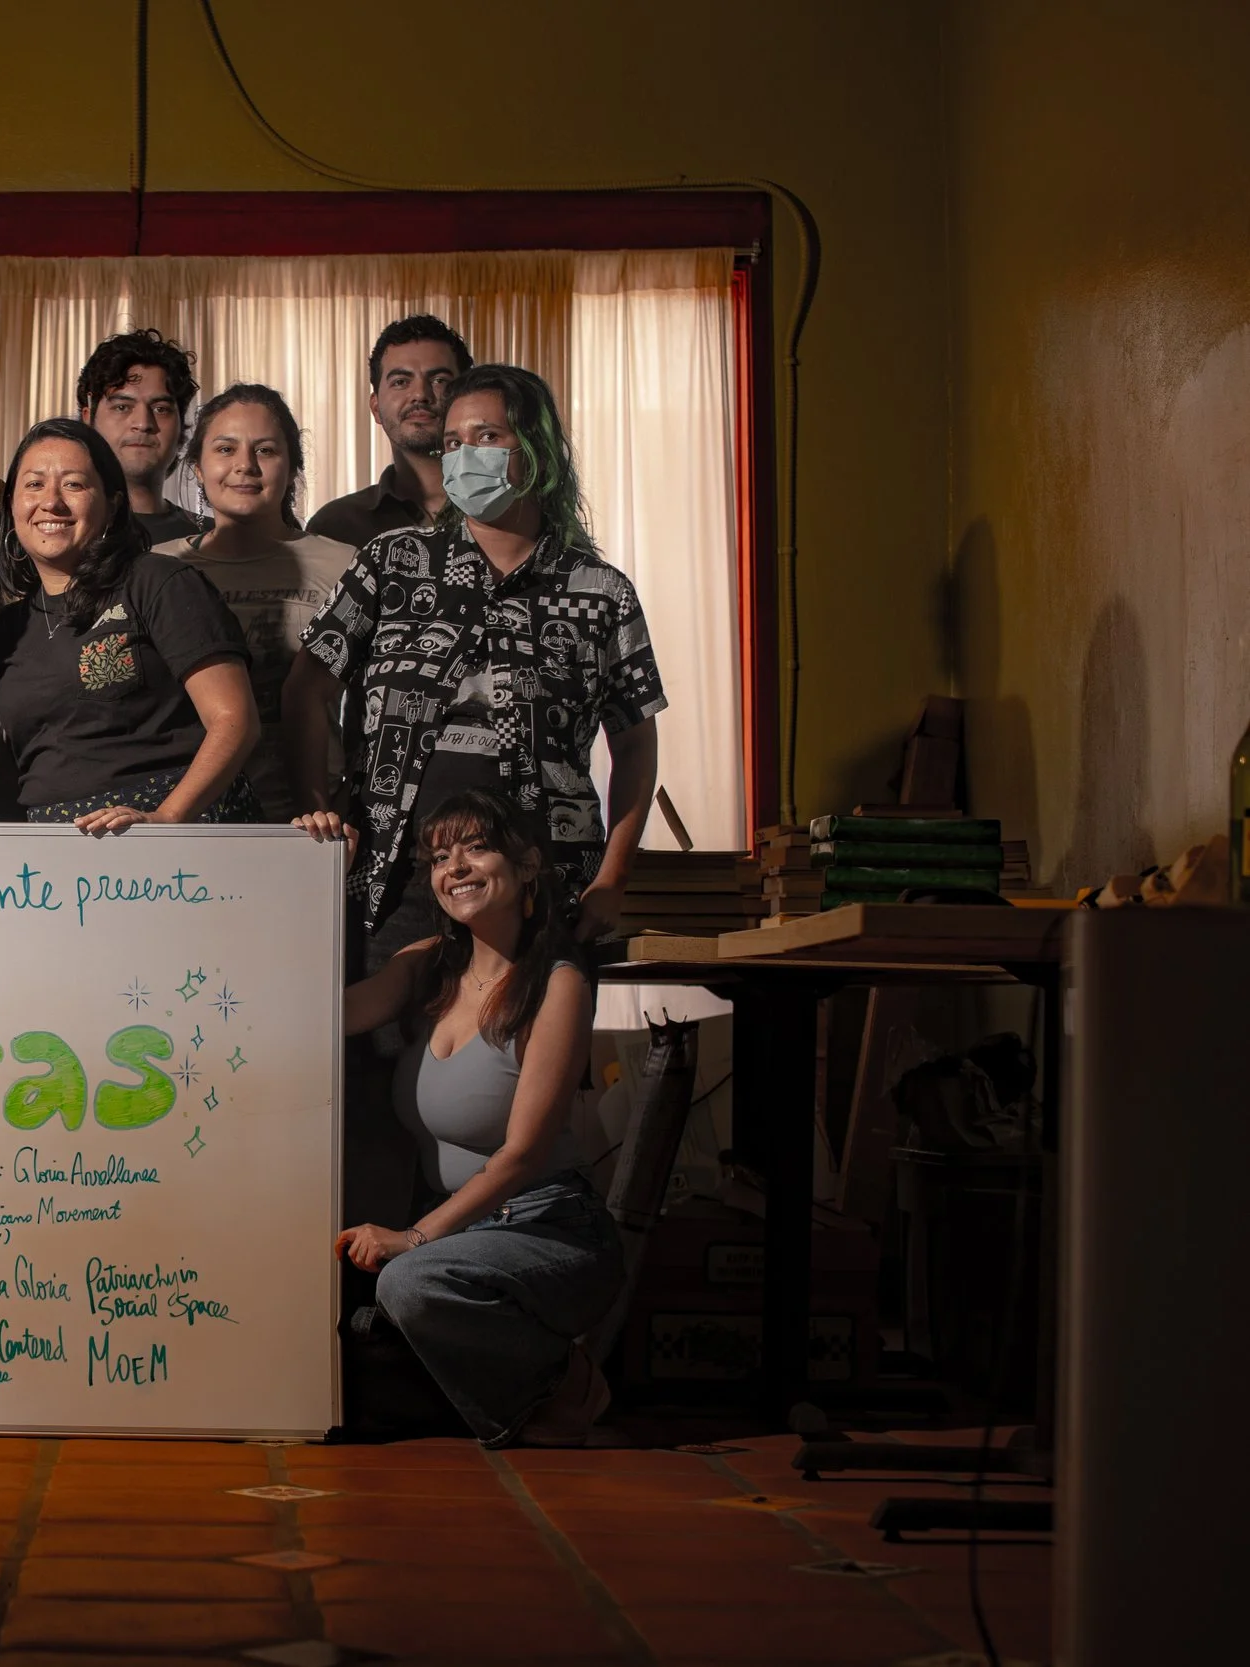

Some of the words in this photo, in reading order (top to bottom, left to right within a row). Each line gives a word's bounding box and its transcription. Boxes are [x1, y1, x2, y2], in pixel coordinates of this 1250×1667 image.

[221, 588, 320, 605] ALESTINE
[367, 660, 441, 678] NOPE
[436, 731, 465, 745] RUTH
[466, 733, 478, 745] IS
[479, 736, 498, 749] OUT
[76, 868, 242, 927] presents...
[14, 1146, 68, 1184] Gloria
[37, 1196, 122, 1224] Movement
[15, 1254, 71, 1302] Gloria
[86, 1256, 180, 1315] Patriarchy
[179, 1256, 198, 1283] in
[98, 1293, 158, 1326] Social
[169, 1292, 240, 1326] Spaces
[88, 1331, 168, 1386] MOEM
